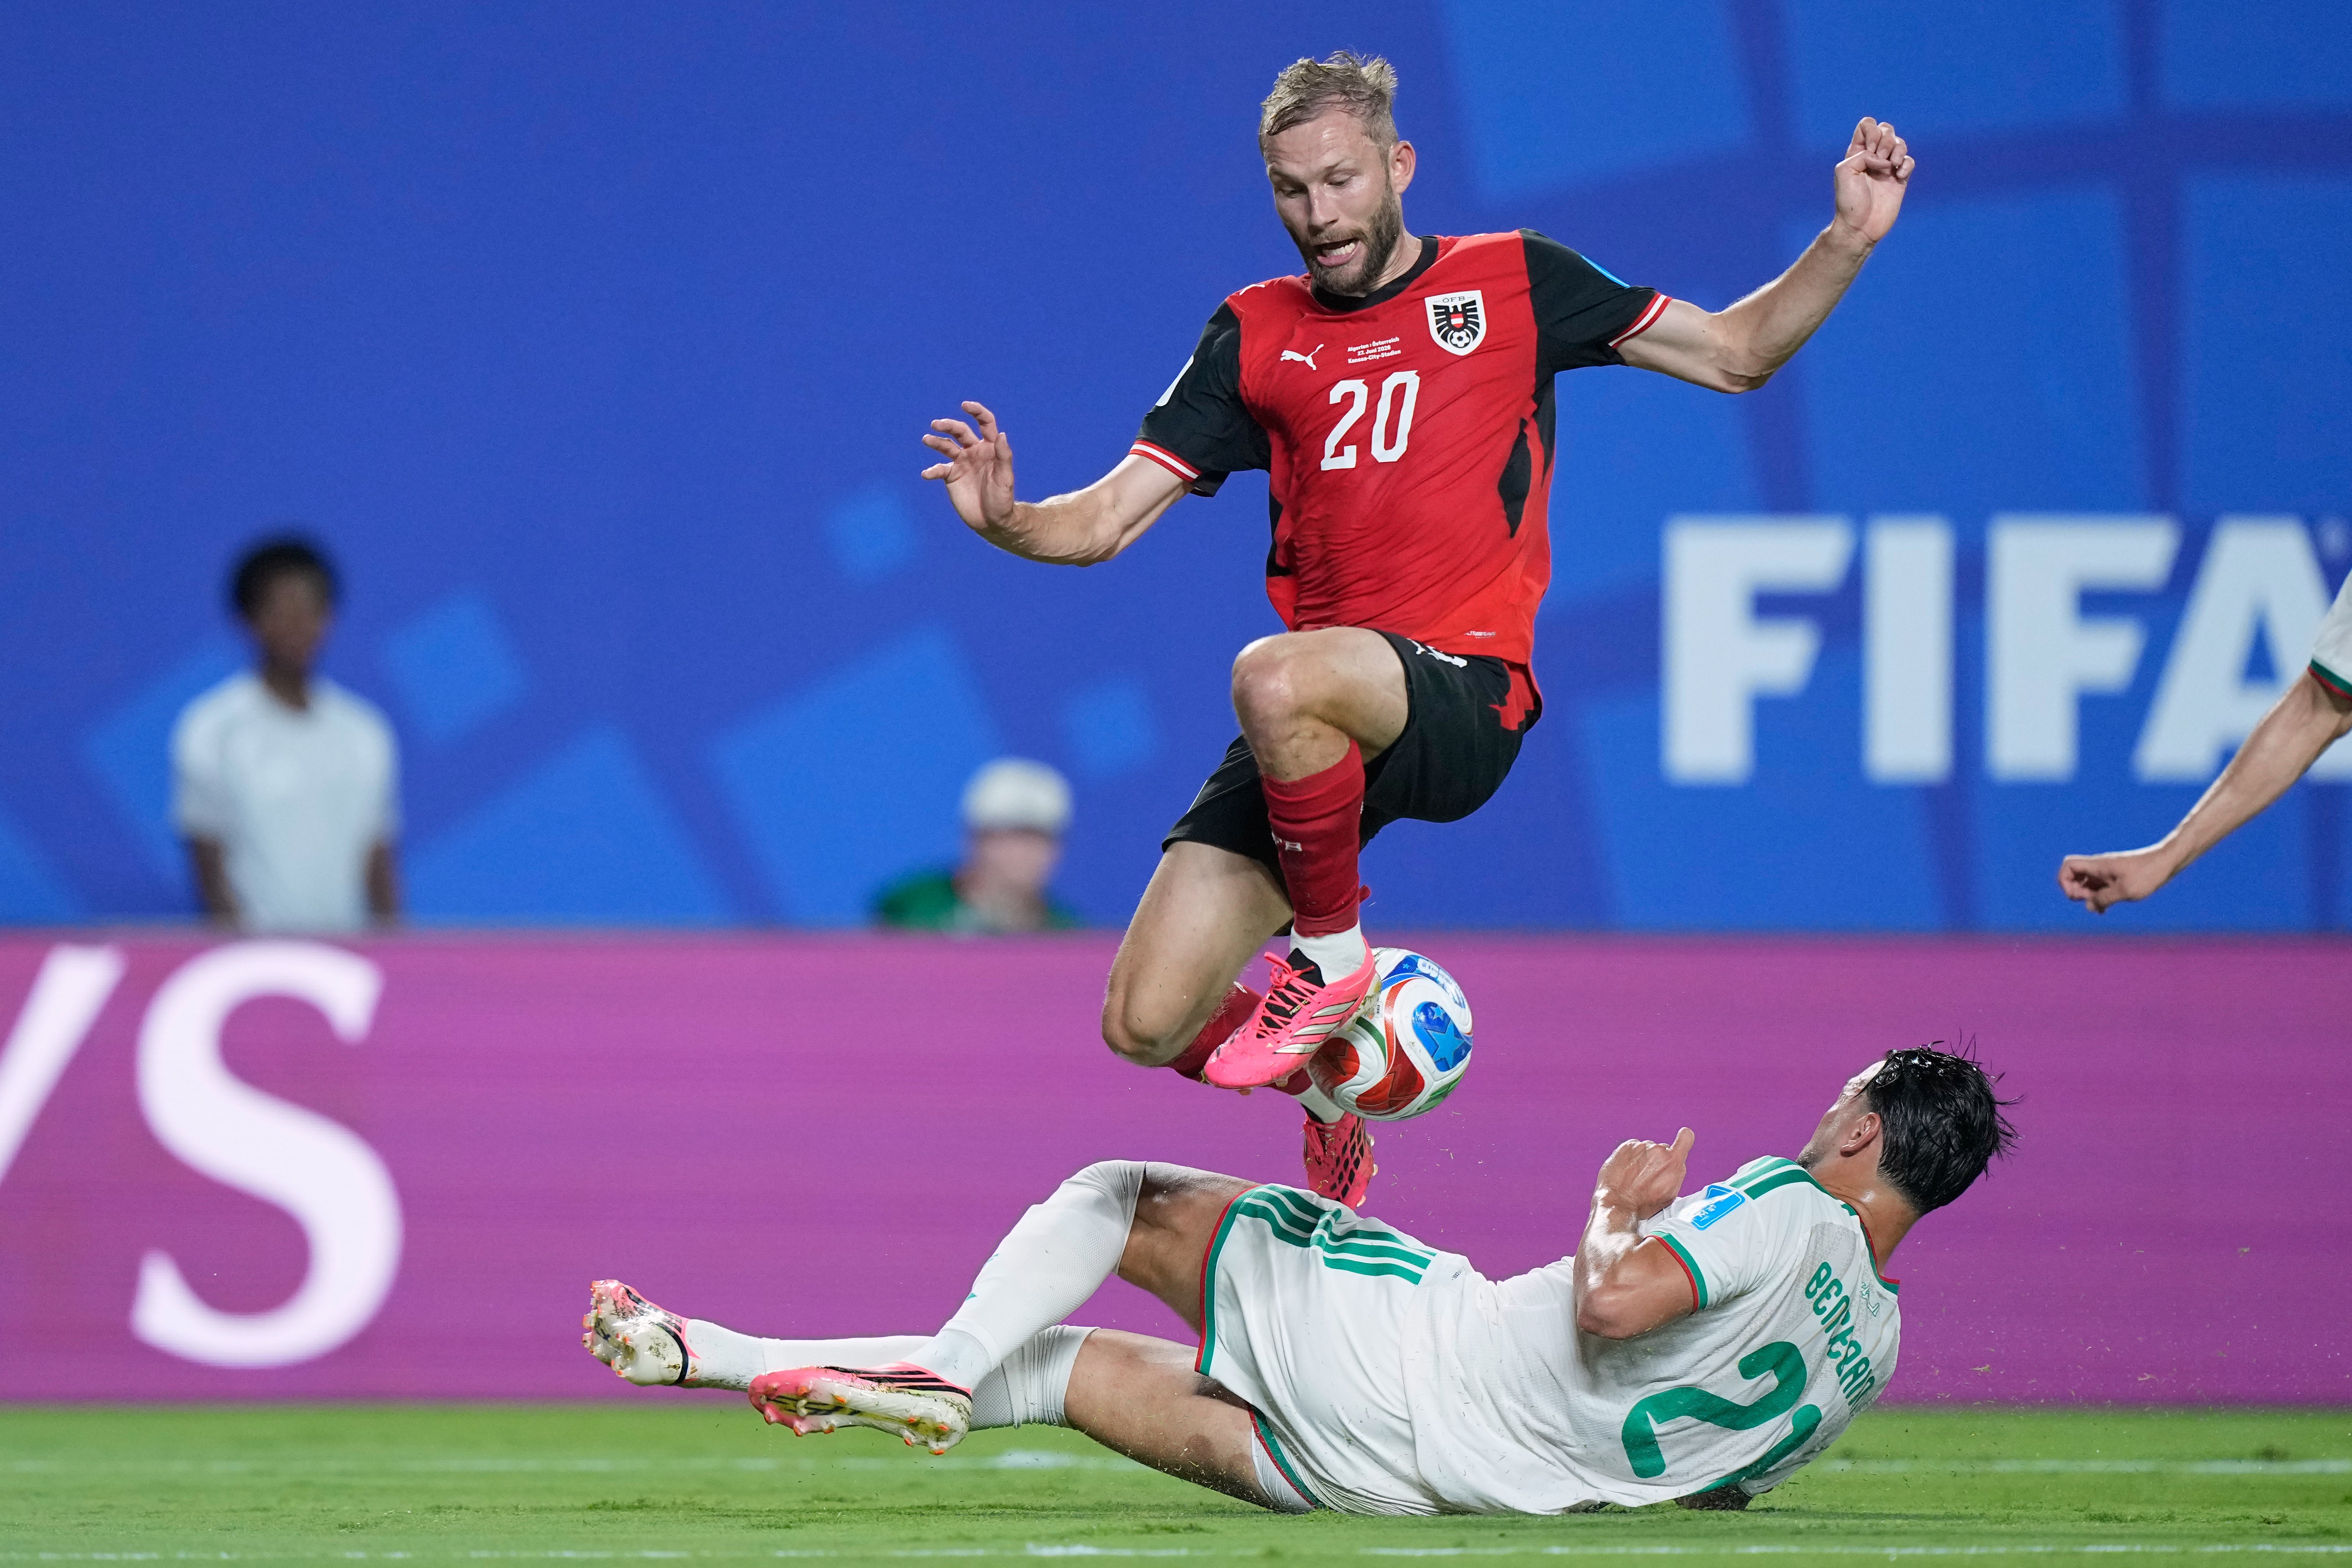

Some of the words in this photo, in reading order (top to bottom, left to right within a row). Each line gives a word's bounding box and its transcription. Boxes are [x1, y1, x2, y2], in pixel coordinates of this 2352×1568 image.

[1348, 350, 1401, 364] Kansas-City-Stadion
[1372, 337, 1400, 347] Österreich
[1320, 370, 1420, 470] 20
[1663, 516, 2352, 784] FIFA
